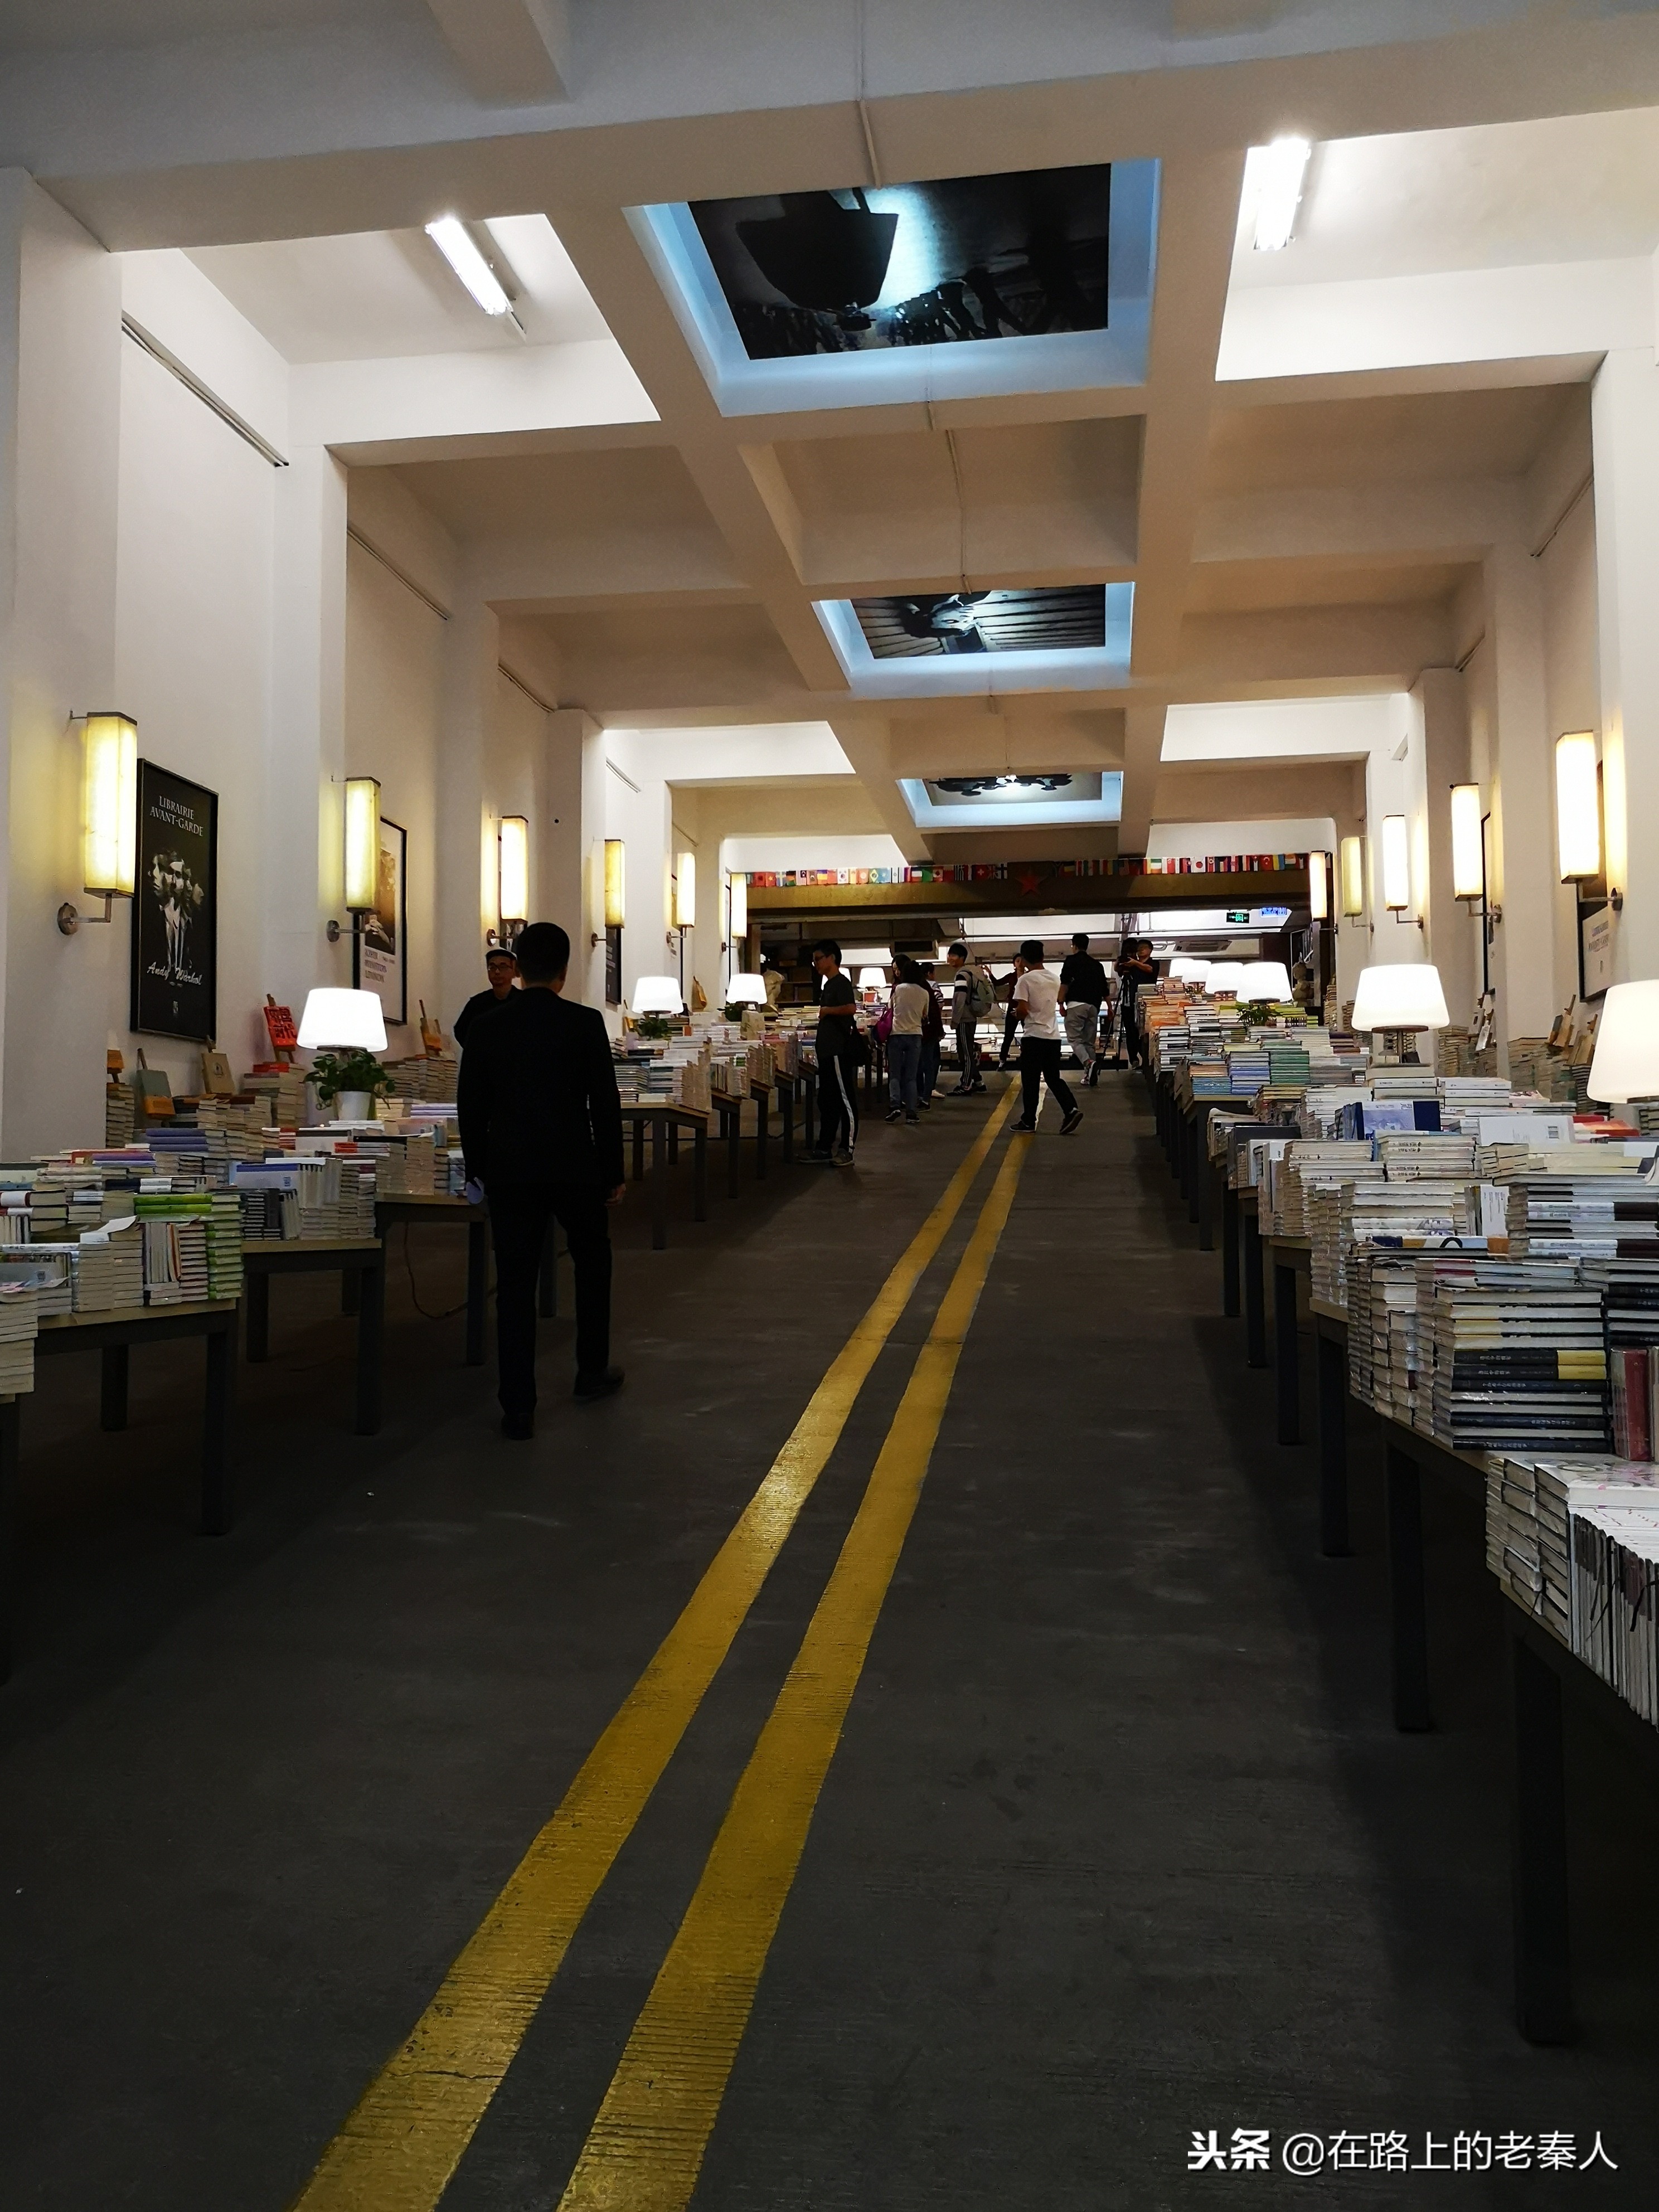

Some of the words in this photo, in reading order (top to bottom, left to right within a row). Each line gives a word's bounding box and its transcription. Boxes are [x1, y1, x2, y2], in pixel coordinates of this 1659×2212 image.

[159, 795, 195, 820] LIBRAIRIE
[149, 806, 204, 837] AVANT-GARDE
[147, 962, 170, 981] Andy
